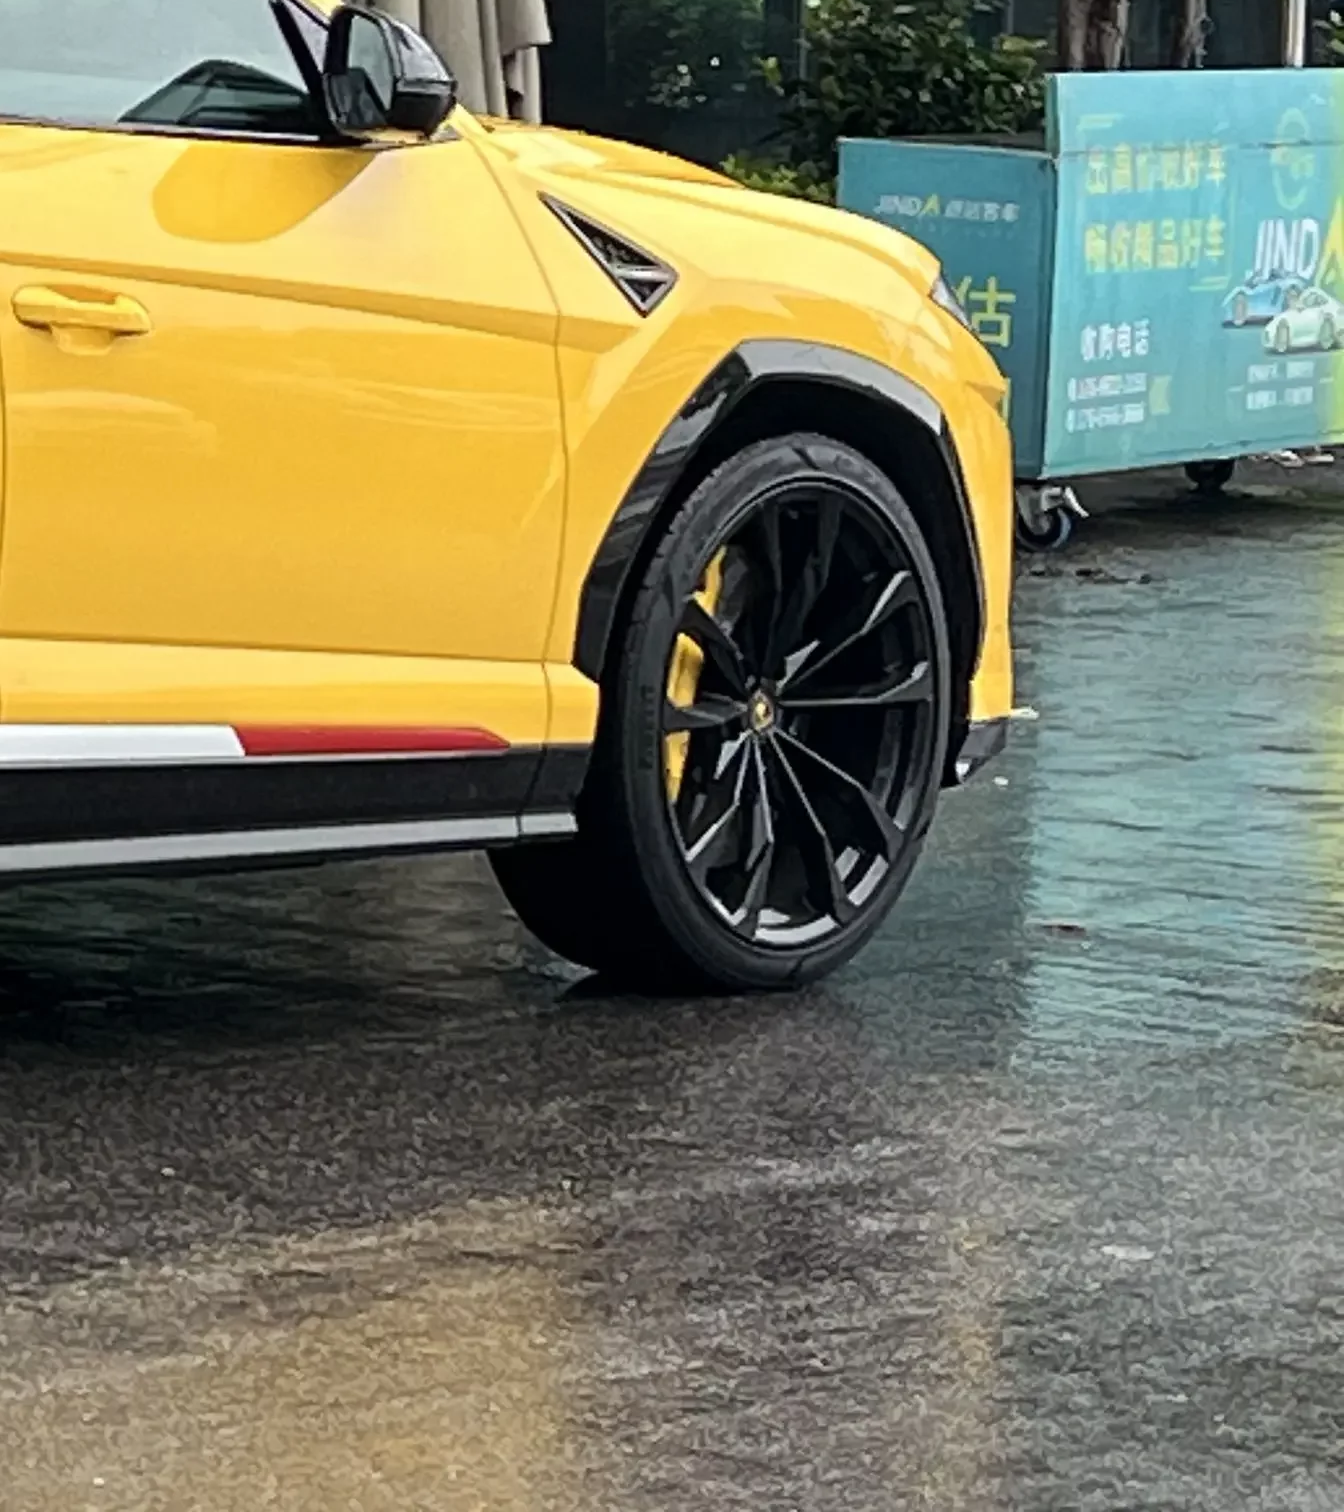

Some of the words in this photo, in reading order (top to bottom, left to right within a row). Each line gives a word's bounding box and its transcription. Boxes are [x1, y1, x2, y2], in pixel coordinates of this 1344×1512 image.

[955, 275, 1017, 349] 估
[1080, 318, 1150, 362] 收购电话
